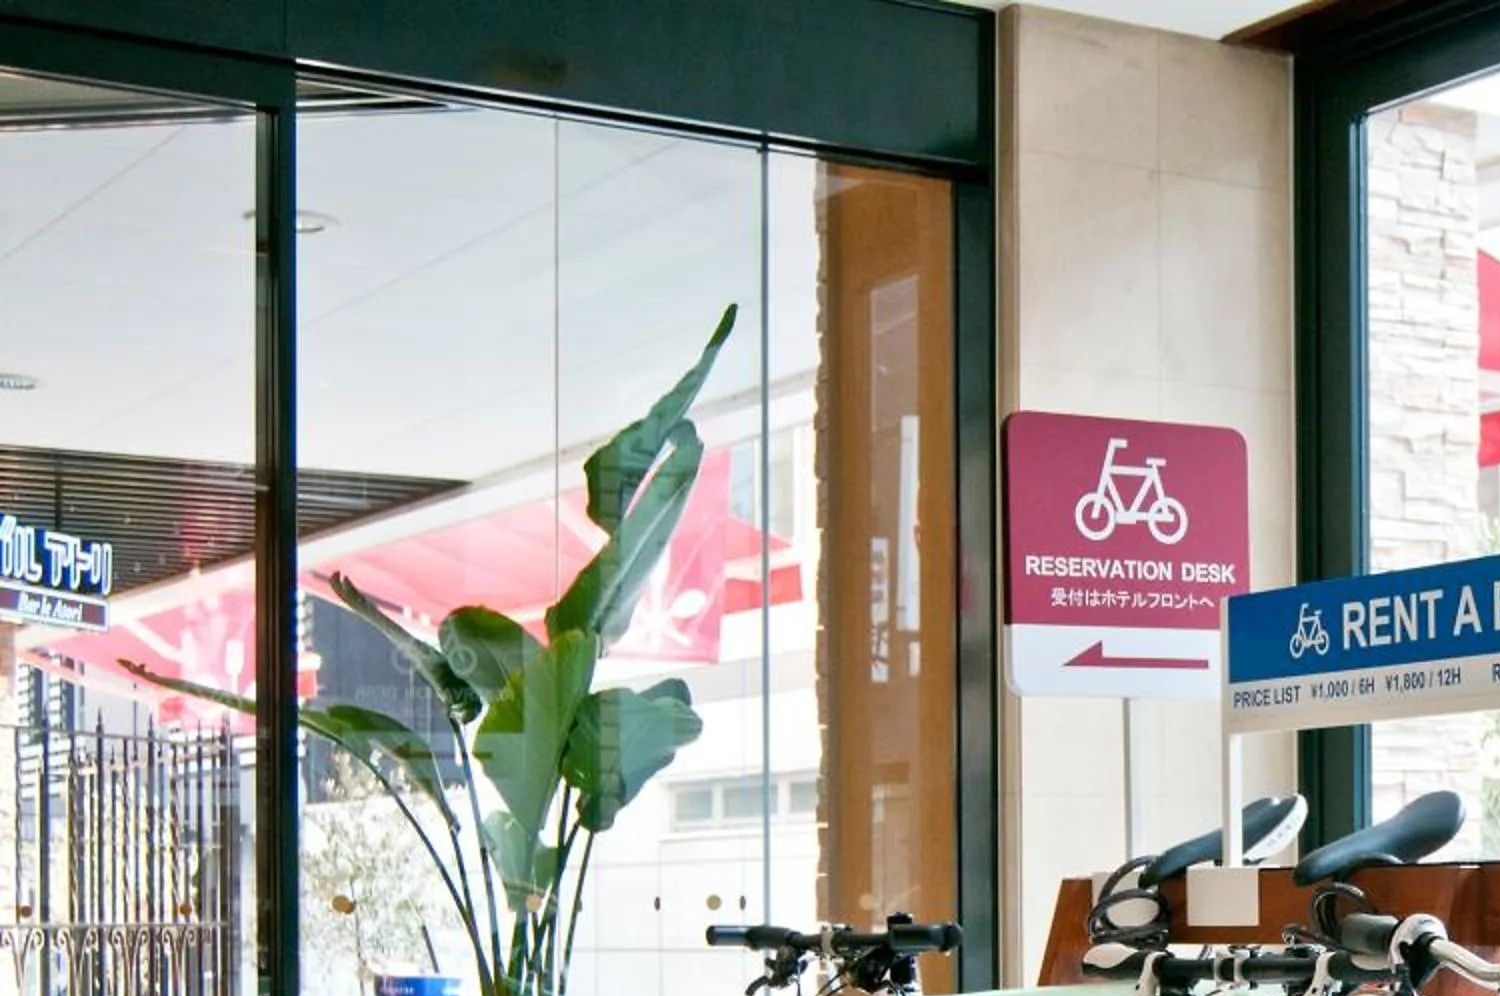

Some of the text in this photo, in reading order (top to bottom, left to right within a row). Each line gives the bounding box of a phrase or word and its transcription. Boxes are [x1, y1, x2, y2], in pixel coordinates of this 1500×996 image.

[1024, 555, 1236, 584] RESERVATION DESK
[1050, 587, 1216, 609] 受付はホテルフロントへ
[1342, 588, 1445, 651] RENT
[1452, 584, 1483, 637] A
[1233, 688, 1272, 710] PRICE
[1274, 685, 1302, 705] LIST
[1438, 667, 1462, 687] 12H
